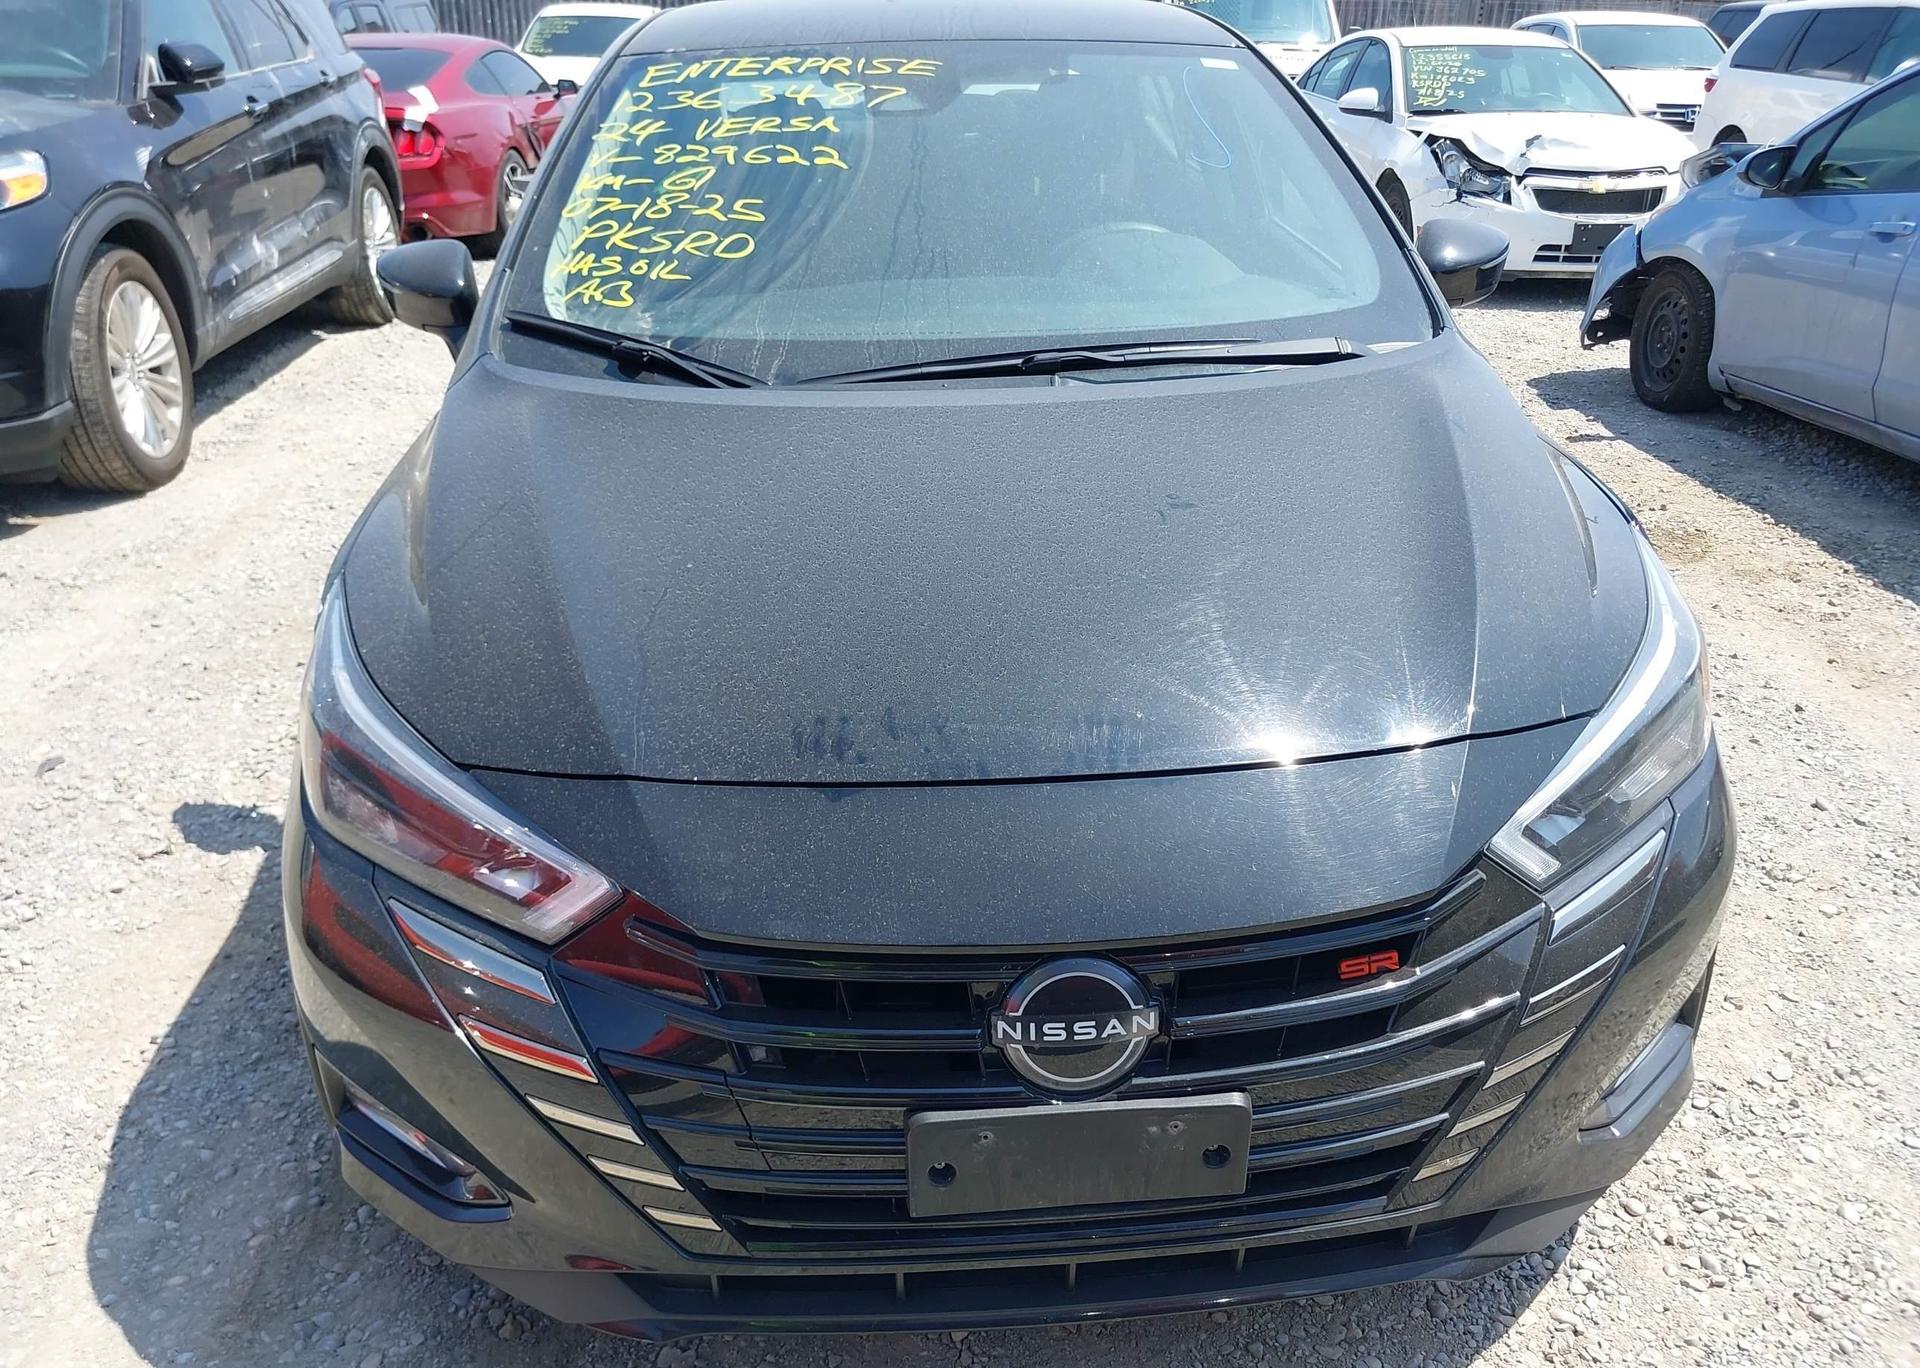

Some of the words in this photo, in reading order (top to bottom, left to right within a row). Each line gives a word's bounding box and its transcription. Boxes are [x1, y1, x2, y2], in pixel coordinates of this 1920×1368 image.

[639, 56, 943, 88] ENTERPRISE
[592, 118, 673, 146] 24
[695, 115, 840, 141] VERSA
[653, 144, 849, 170] 829622
[561, 192, 766, 222] 07-18-25
[571, 220, 756, 260] PKSRD
[1338, 949, 1400, 980] SR
[996, 1011, 1155, 1042] NISSAN
